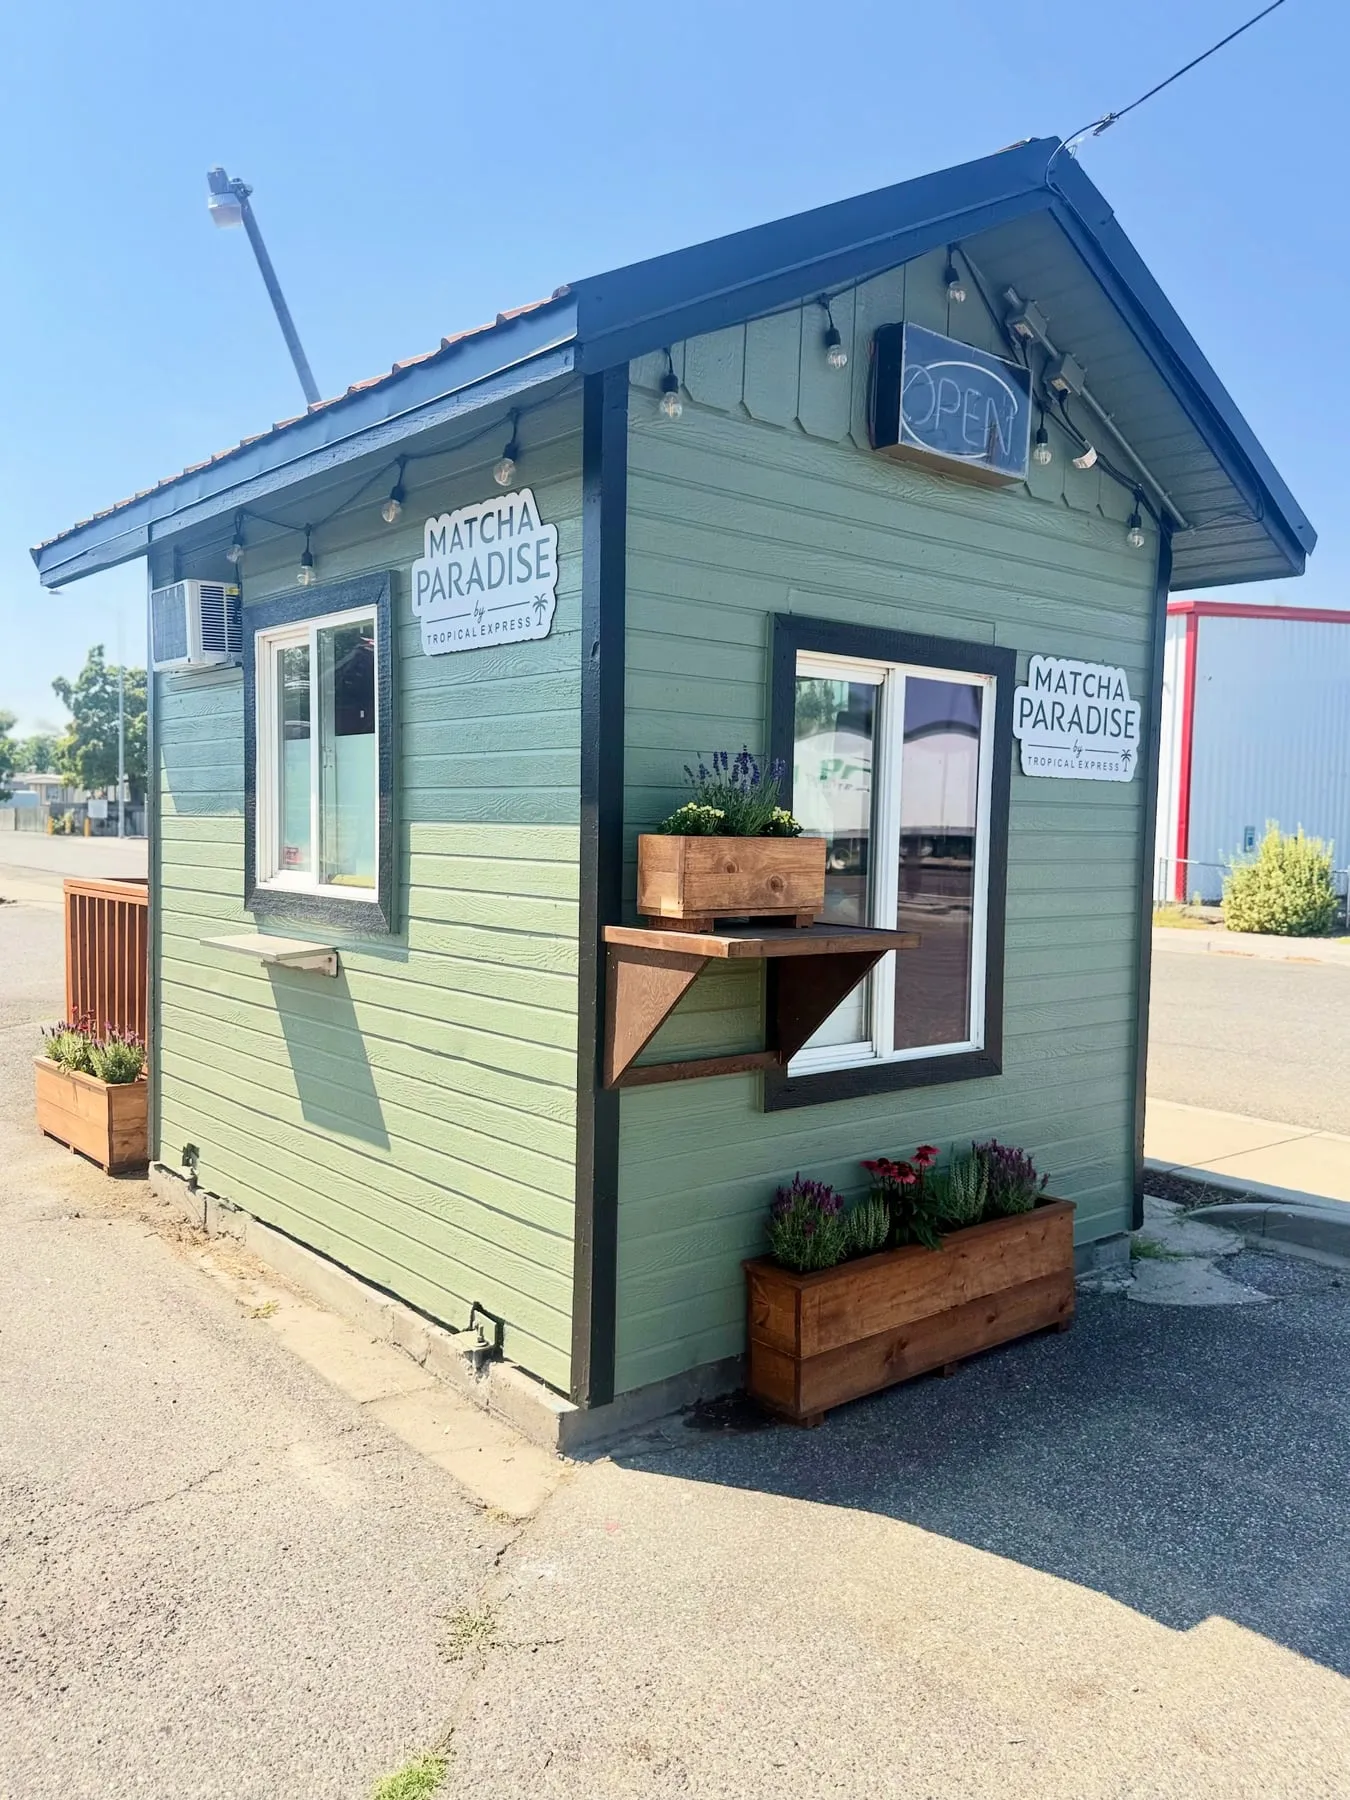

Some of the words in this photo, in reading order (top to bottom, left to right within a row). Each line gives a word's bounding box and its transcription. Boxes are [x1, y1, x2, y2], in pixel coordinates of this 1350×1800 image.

[902, 364, 1014, 455] OPEN
[430, 501, 534, 559] MATCHA
[416, 537, 551, 606] PARADISE
[427, 625, 477, 645] TROPICAL
[480, 616, 531, 636] EXPRESS
[473, 600, 486, 624] by
[1035, 665, 1125, 702] MATCHA
[1019, 697, 1136, 739] PARADISE
[1028, 756, 1075, 769] TROPICAL
[1078, 760, 1120, 772] EXPRESS
[1072, 738, 1083, 758] by
